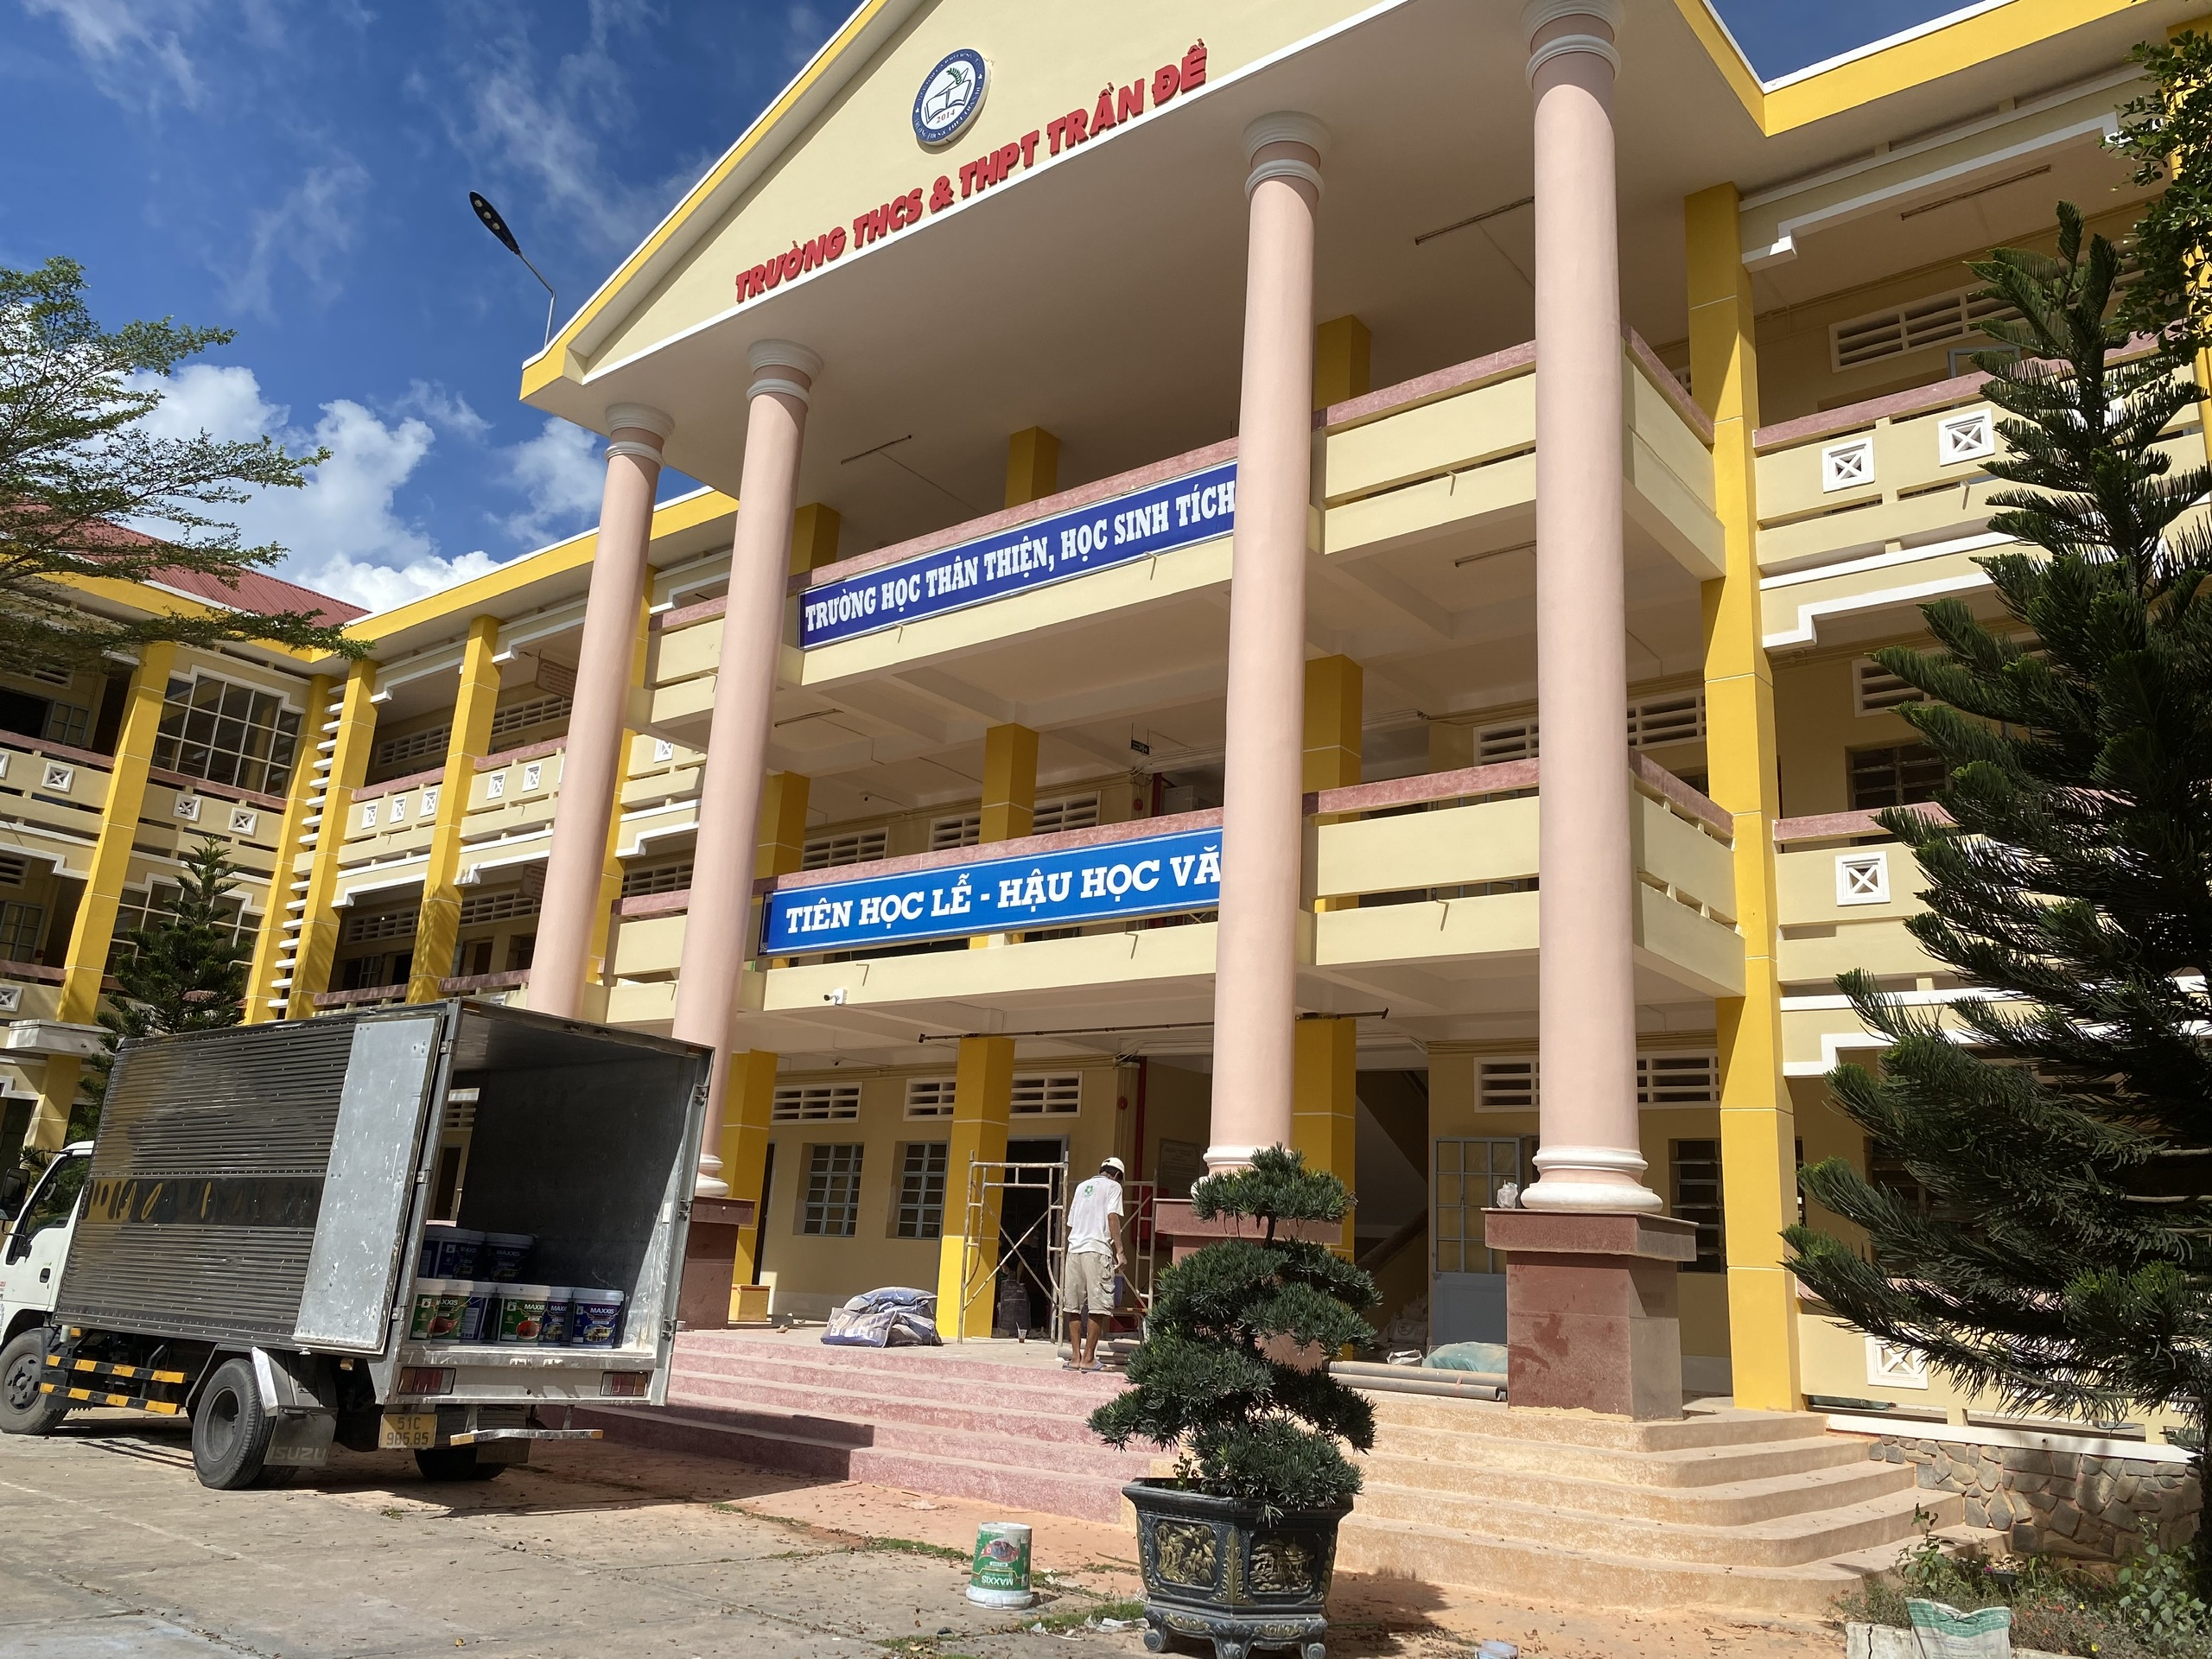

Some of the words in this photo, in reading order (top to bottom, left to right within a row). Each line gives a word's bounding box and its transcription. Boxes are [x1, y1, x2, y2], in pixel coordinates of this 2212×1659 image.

[936, 109, 956, 124] 2014
[735, 226, 846, 302] TRƯỜNG
[853, 188, 923, 248] THCS
[929, 175, 954, 213] &
[959, 130, 1039, 199] THPT
[1046, 79, 1144, 156] TRẦN
[1151, 38, 1208, 105] ĐỀ
[805, 586, 877, 632] TRƯỜNG
[880, 578, 921, 613] HỌC
[925, 555, 978, 598] THÂN
[983, 535, 1056, 579] THIỆN,
[1060, 521, 1109, 563] HỌC
[1114, 500, 1169, 545] SINH
[1176, 480, 1235, 527] TÍCH
[786, 896, 853, 934] TIÊN
[858, 891, 925, 930] HỌC
[930, 873, 972, 918] LỄ
[980, 892, 991, 901] -
[997, 869, 1071, 912] HẬU
[1080, 864, 1160, 902] HỌC
[1169, 844, 1221, 887] VĂ
[397, 1417, 421, 1430] 51C
[271, 1446, 327, 1461] ISUZU
[982, 1574, 1014, 1586] MAXXIS
